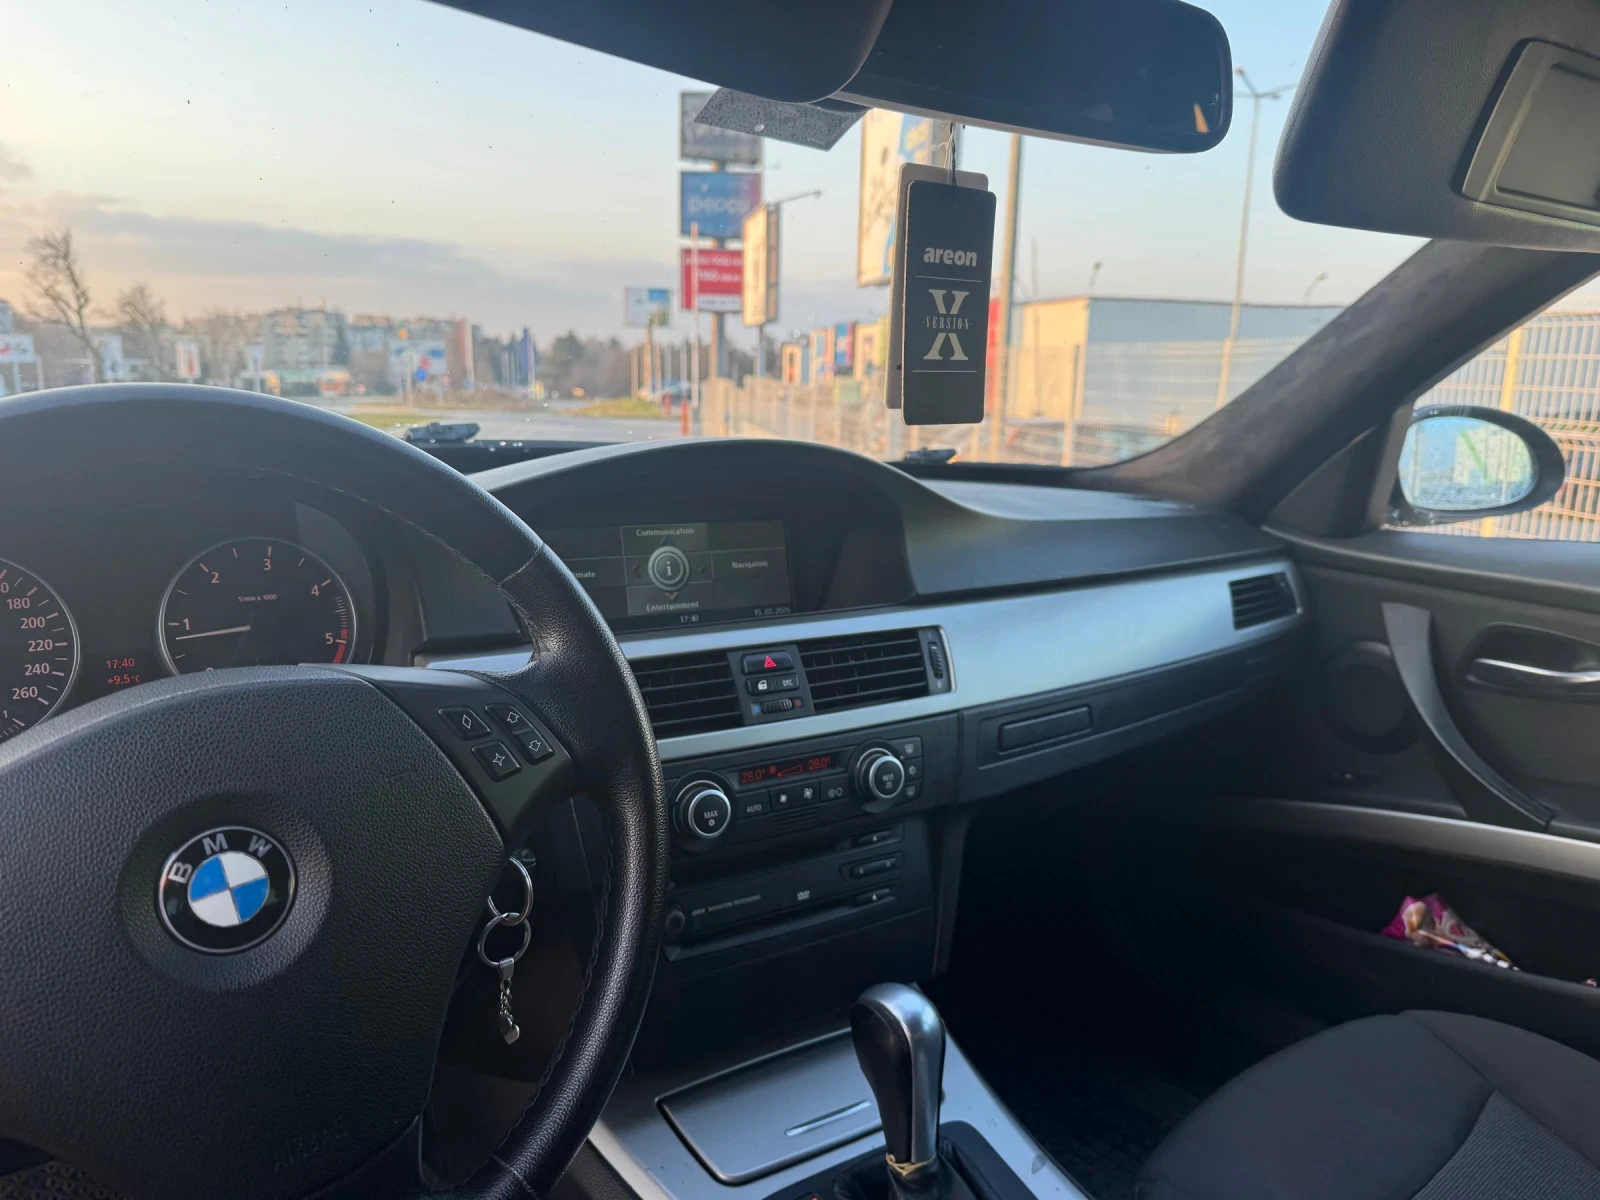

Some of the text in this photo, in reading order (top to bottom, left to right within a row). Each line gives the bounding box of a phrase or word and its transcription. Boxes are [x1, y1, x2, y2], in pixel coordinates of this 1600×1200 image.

[923, 247, 977, 267] areon
[636, 527, 695, 537] Communication
[263, 558, 272, 571] 3
[732, 560, 768, 570] Navigation
[211, 571, 220, 584] 2
[574, 571, 596, 579] mate
[311, 584, 320, 597] 4
[6, 597, 31, 610] 180
[646, 601, 699, 612] Entertainment
[20, 616, 46, 629] 200
[182, 618, 190, 631] 1
[680, 614, 700, 623] 17:40
[325, 632, 334, 645] 5
[27, 639, 53, 652] 220
[24, 662, 50, 676] 240
[106, 658, 135, 669] 17:40
[782, 678, 793, 688] DTC
[12, 686, 38, 700] 260
[703, 809, 719, 819] MAX
[746, 803, 762, 813] AUTO
[168, 832, 273, 884] BMW
